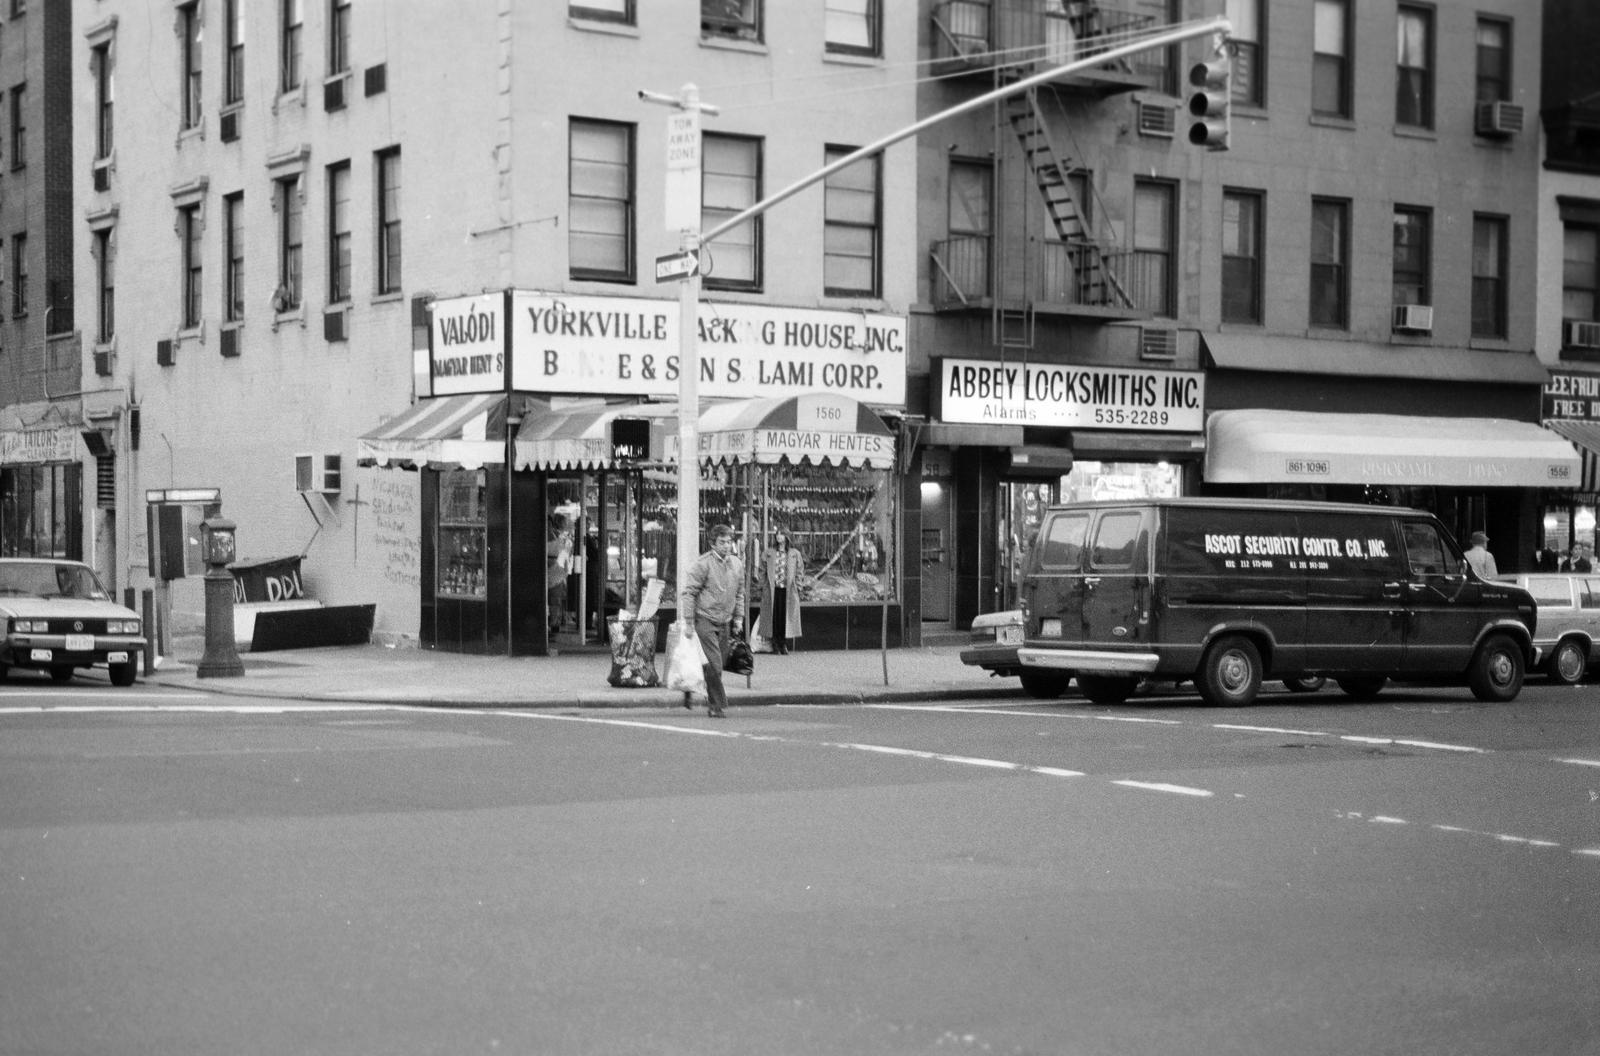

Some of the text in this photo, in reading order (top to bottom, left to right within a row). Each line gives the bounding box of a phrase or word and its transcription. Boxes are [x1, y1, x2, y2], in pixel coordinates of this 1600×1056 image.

[674, 119, 692, 130] TOW
[670, 134, 695, 145] AWAY
[670, 149, 695, 160] ZONE
[440, 303, 495, 346] VALÓDI
[528, 307, 667, 340] YORKVILLE
[784, 321, 856, 350] HOUSE
[864, 326, 903, 353] INC.
[470, 352, 503, 378] HENTS
[641, 354, 656, 380] &
[666, 355, 715, 382] SN
[727, 358, 814, 387] SLAMI
[822, 363, 882, 390] CORP.
[950, 365, 1199, 409] ABBEY LOCKSMITHS INC.
[816, 407, 841, 419] 1560
[983, 404, 1037, 421] Alarms
[1553, 400, 1585, 416] FREE
[767, 431, 881, 452] MAGYAR HENTES
[1205, 534, 1241, 554] ASCOT
[1245, 535, 1299, 555] SECURITY
[1303, 537, 1342, 557] CONTR.
